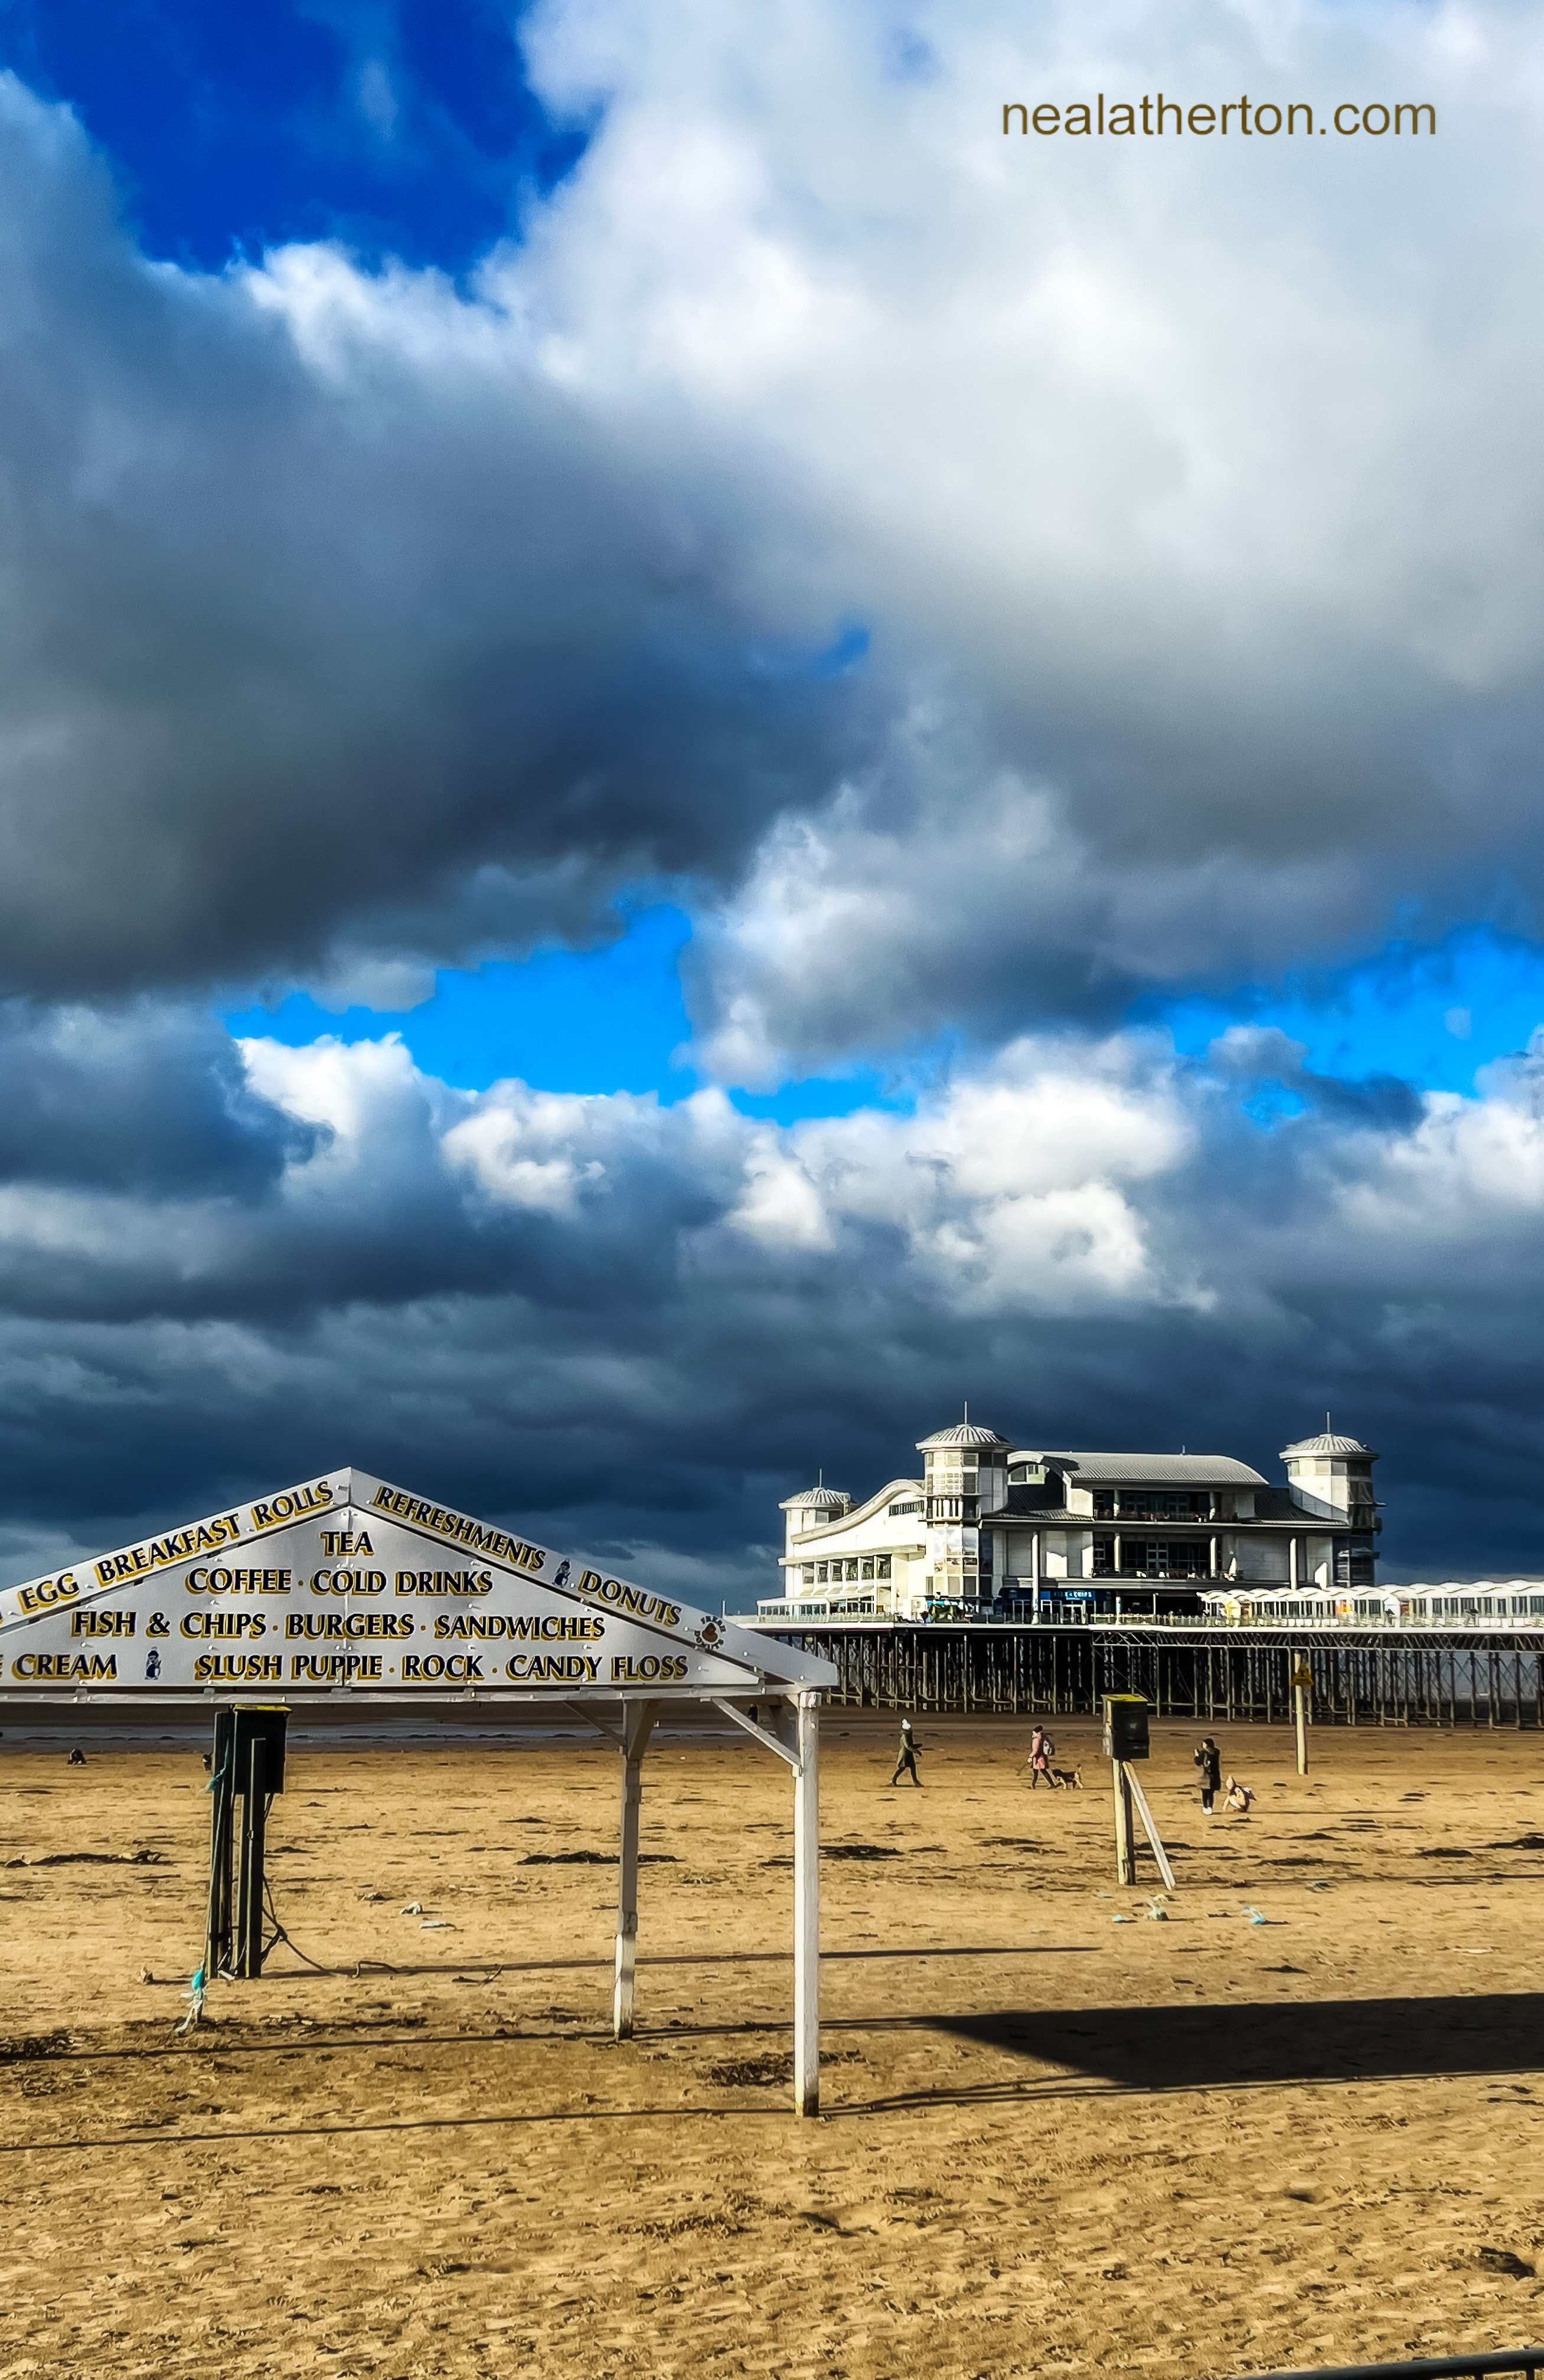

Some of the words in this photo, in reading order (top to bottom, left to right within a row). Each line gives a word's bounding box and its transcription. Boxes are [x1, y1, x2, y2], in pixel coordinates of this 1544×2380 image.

[17, 1573, 80, 1615] EGG
[93, 1513, 241, 1587] BREAKFAST
[251, 1481, 334, 1531] ROLLS
[320, 1531, 374, 1557] TEA
[373, 1486, 546, 1572] REFRESHMENTS
[577, 1570, 681, 1627] DONUTS
[185, 1568, 292, 1594] COFFEE
[309, 1570, 387, 1596] COLD
[395, 1571, 493, 1596] DRINKS
[71, 1611, 136, 1637] FISH
[146, 1612, 171, 1637] &
[179, 1612, 266, 1639] CHIPS
[285, 1613, 414, 1640] BURGERS
[434, 1614, 605, 1641] SANDWICHES
[11, 1653, 117, 1680] CREAM
[194, 1655, 283, 1681] SLUSH
[290, 1655, 383, 1681] PUPPIE
[401, 1655, 485, 1681] ROCK
[505, 1655, 602, 1681] CANDY
[611, 1655, 688, 1681] FLOSS
